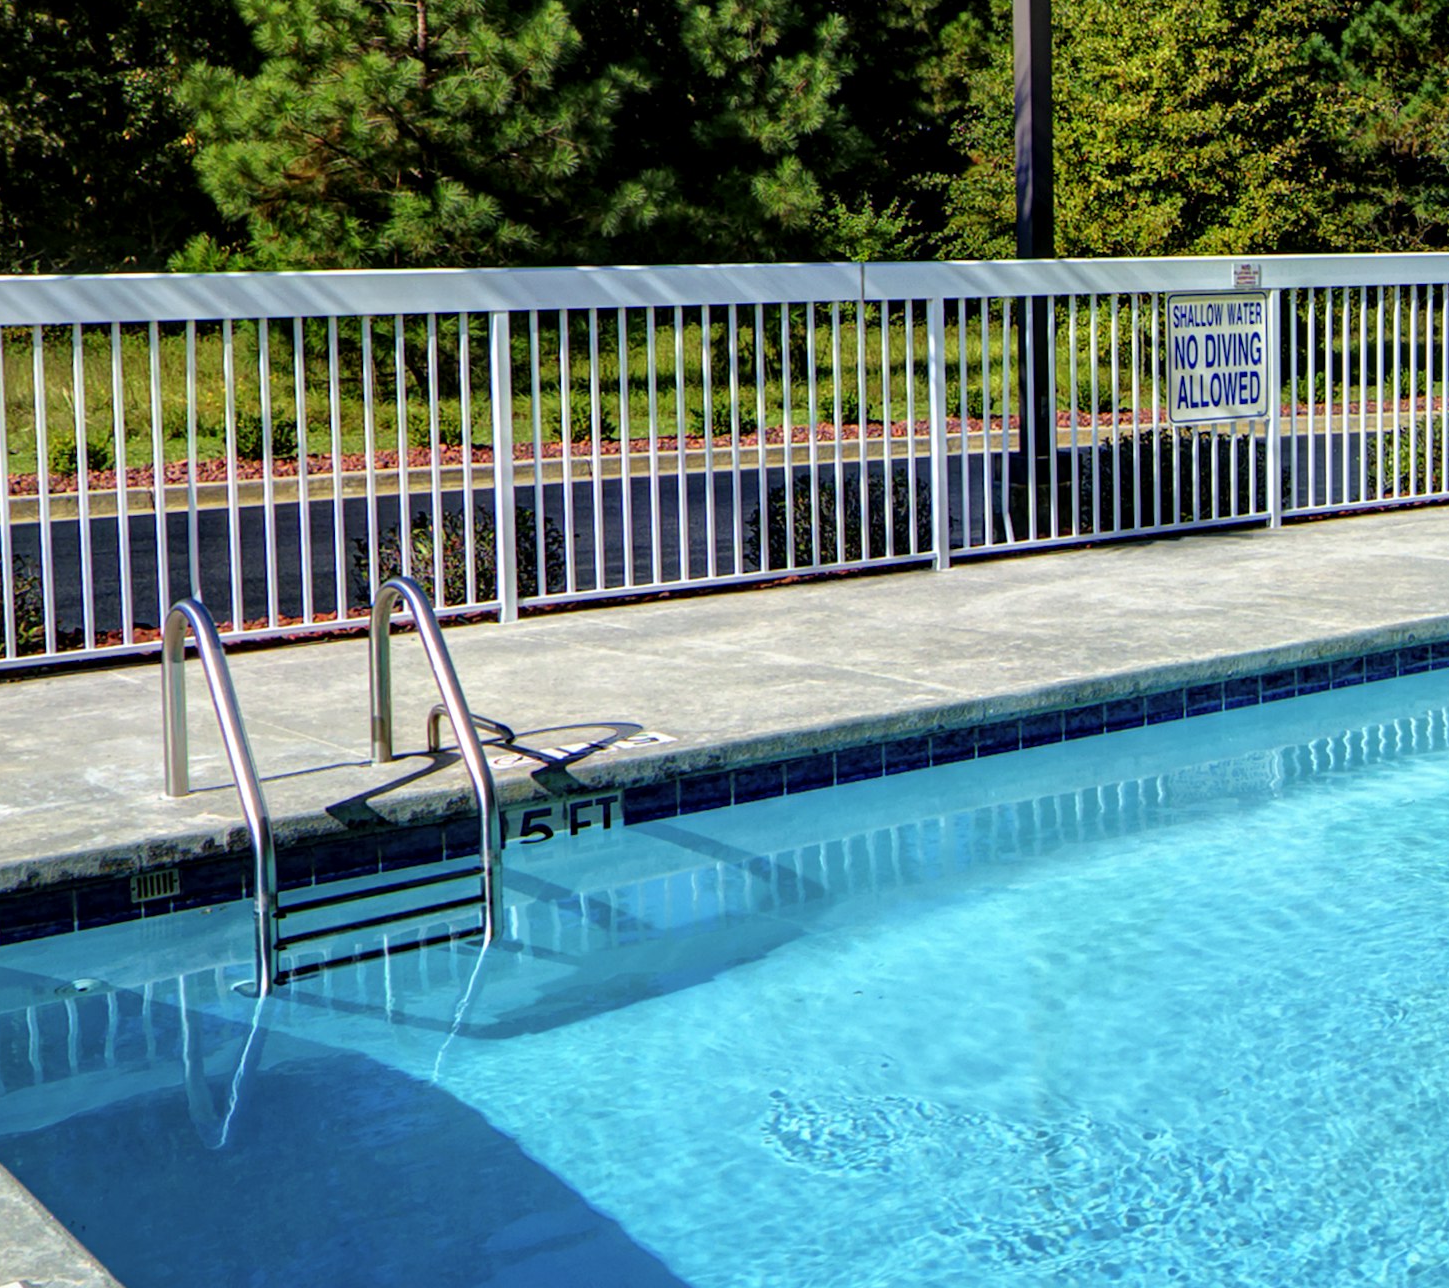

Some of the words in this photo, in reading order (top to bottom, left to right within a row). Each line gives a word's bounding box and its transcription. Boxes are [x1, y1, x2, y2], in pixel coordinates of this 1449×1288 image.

[1173, 303, 1223, 328] SHALLOW
[1227, 302, 1262, 326] WATER
[1174, 334, 1198, 370] NO
[1205, 331, 1262, 368] DIVING
[1177, 371, 1261, 410] ALLOWED
[520, 808, 554, 845] 5
[569, 795, 619, 836] FT
